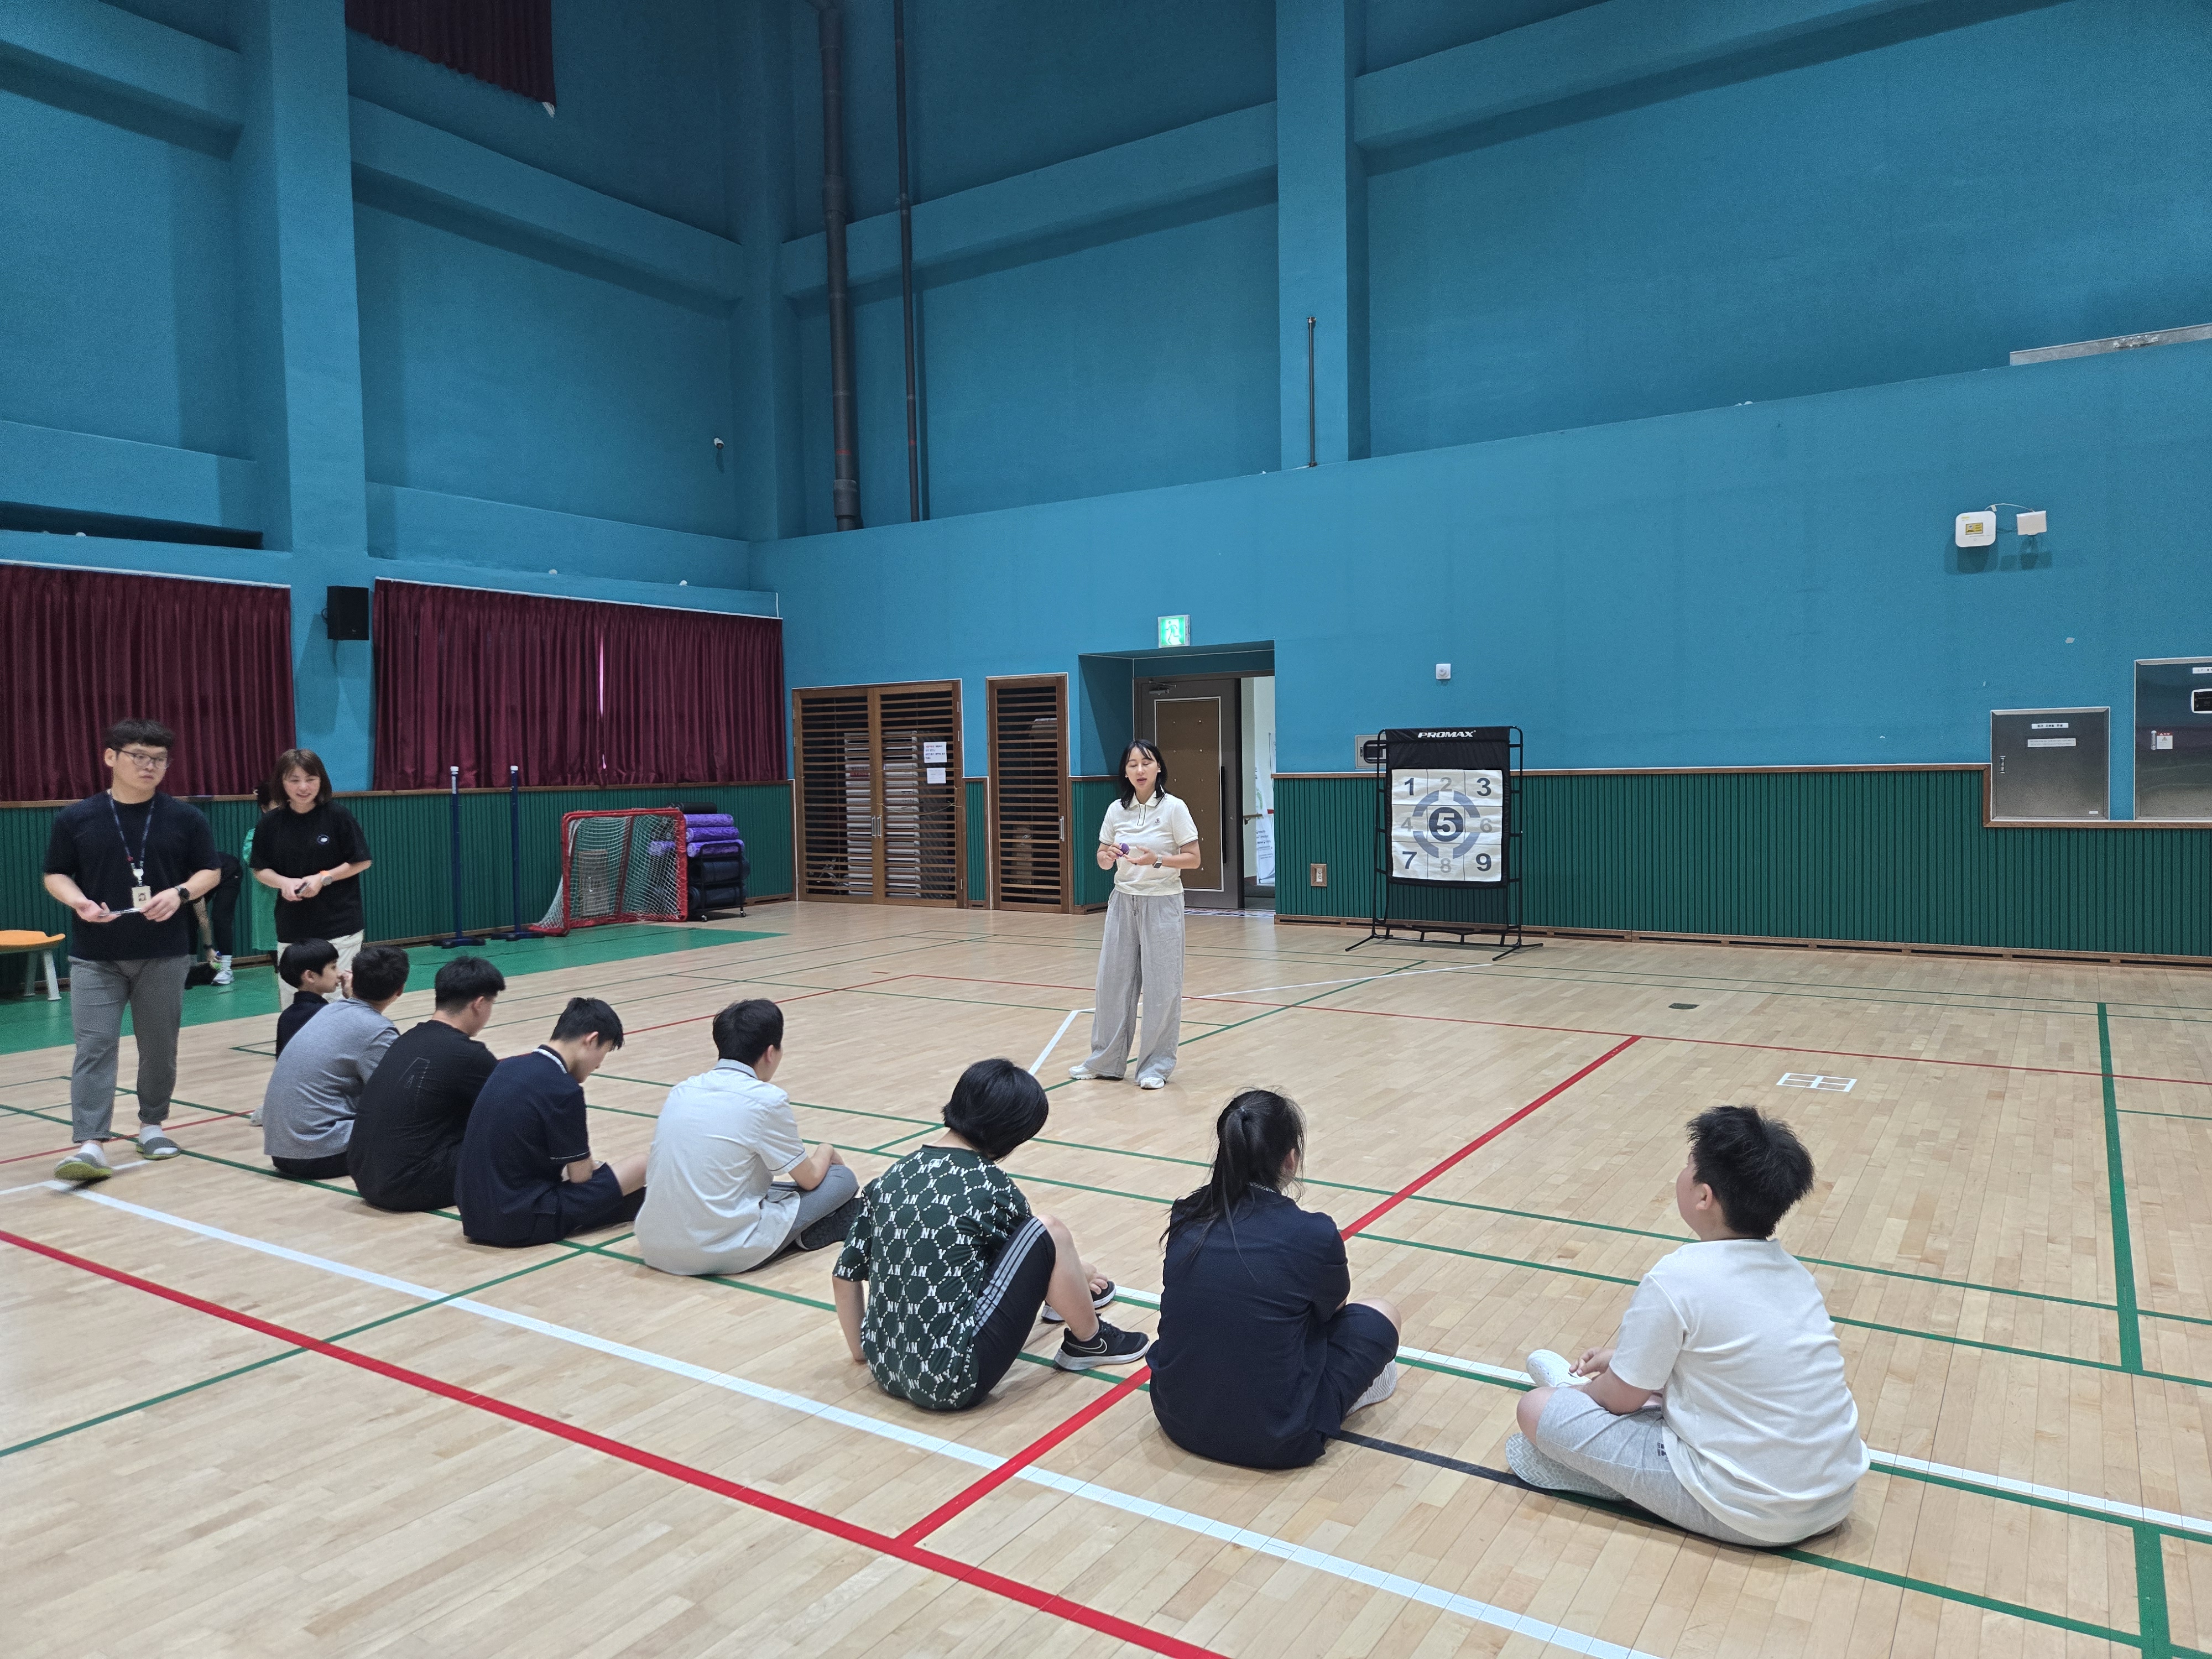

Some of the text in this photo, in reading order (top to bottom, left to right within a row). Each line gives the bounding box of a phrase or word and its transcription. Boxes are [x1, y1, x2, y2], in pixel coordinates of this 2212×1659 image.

[1404, 778, 1414, 796] 1
[1439, 777, 1452, 791] 2
[1477, 778, 1491, 796] 3
[1401, 817, 1413, 832] 4
[1437, 813, 1457, 836] 5
[1480, 818, 1493, 833] 6
[1402, 851, 1417, 869] 7
[1440, 858, 1452, 873] 8
[1476, 853, 1491, 872] 9
[891, 1164, 905, 1172] NY
[948, 1166, 968, 1176] NY
[927, 1179, 937, 1188] N
[888, 1211, 897, 1222] N
[947, 1215, 958, 1227] N
[874, 1226, 883, 1237] NY
[894, 1228, 908, 1239] NY
[920, 1227, 938, 1239] NY
[955, 1234, 973, 1245] NY
[905, 1246, 912, 1258] N
[938, 1249, 946, 1259] Y
[838, 1265, 853, 1277] NY
[927, 1285, 937, 1296] N
[887, 1301, 899, 1313] NY
[907, 1303, 920, 1314] NY
[937, 1302, 956, 1314] NY
[922, 1323, 930, 1334] Y
[878, 1352, 885, 1363] N
[921, 1360, 929, 1372] N
